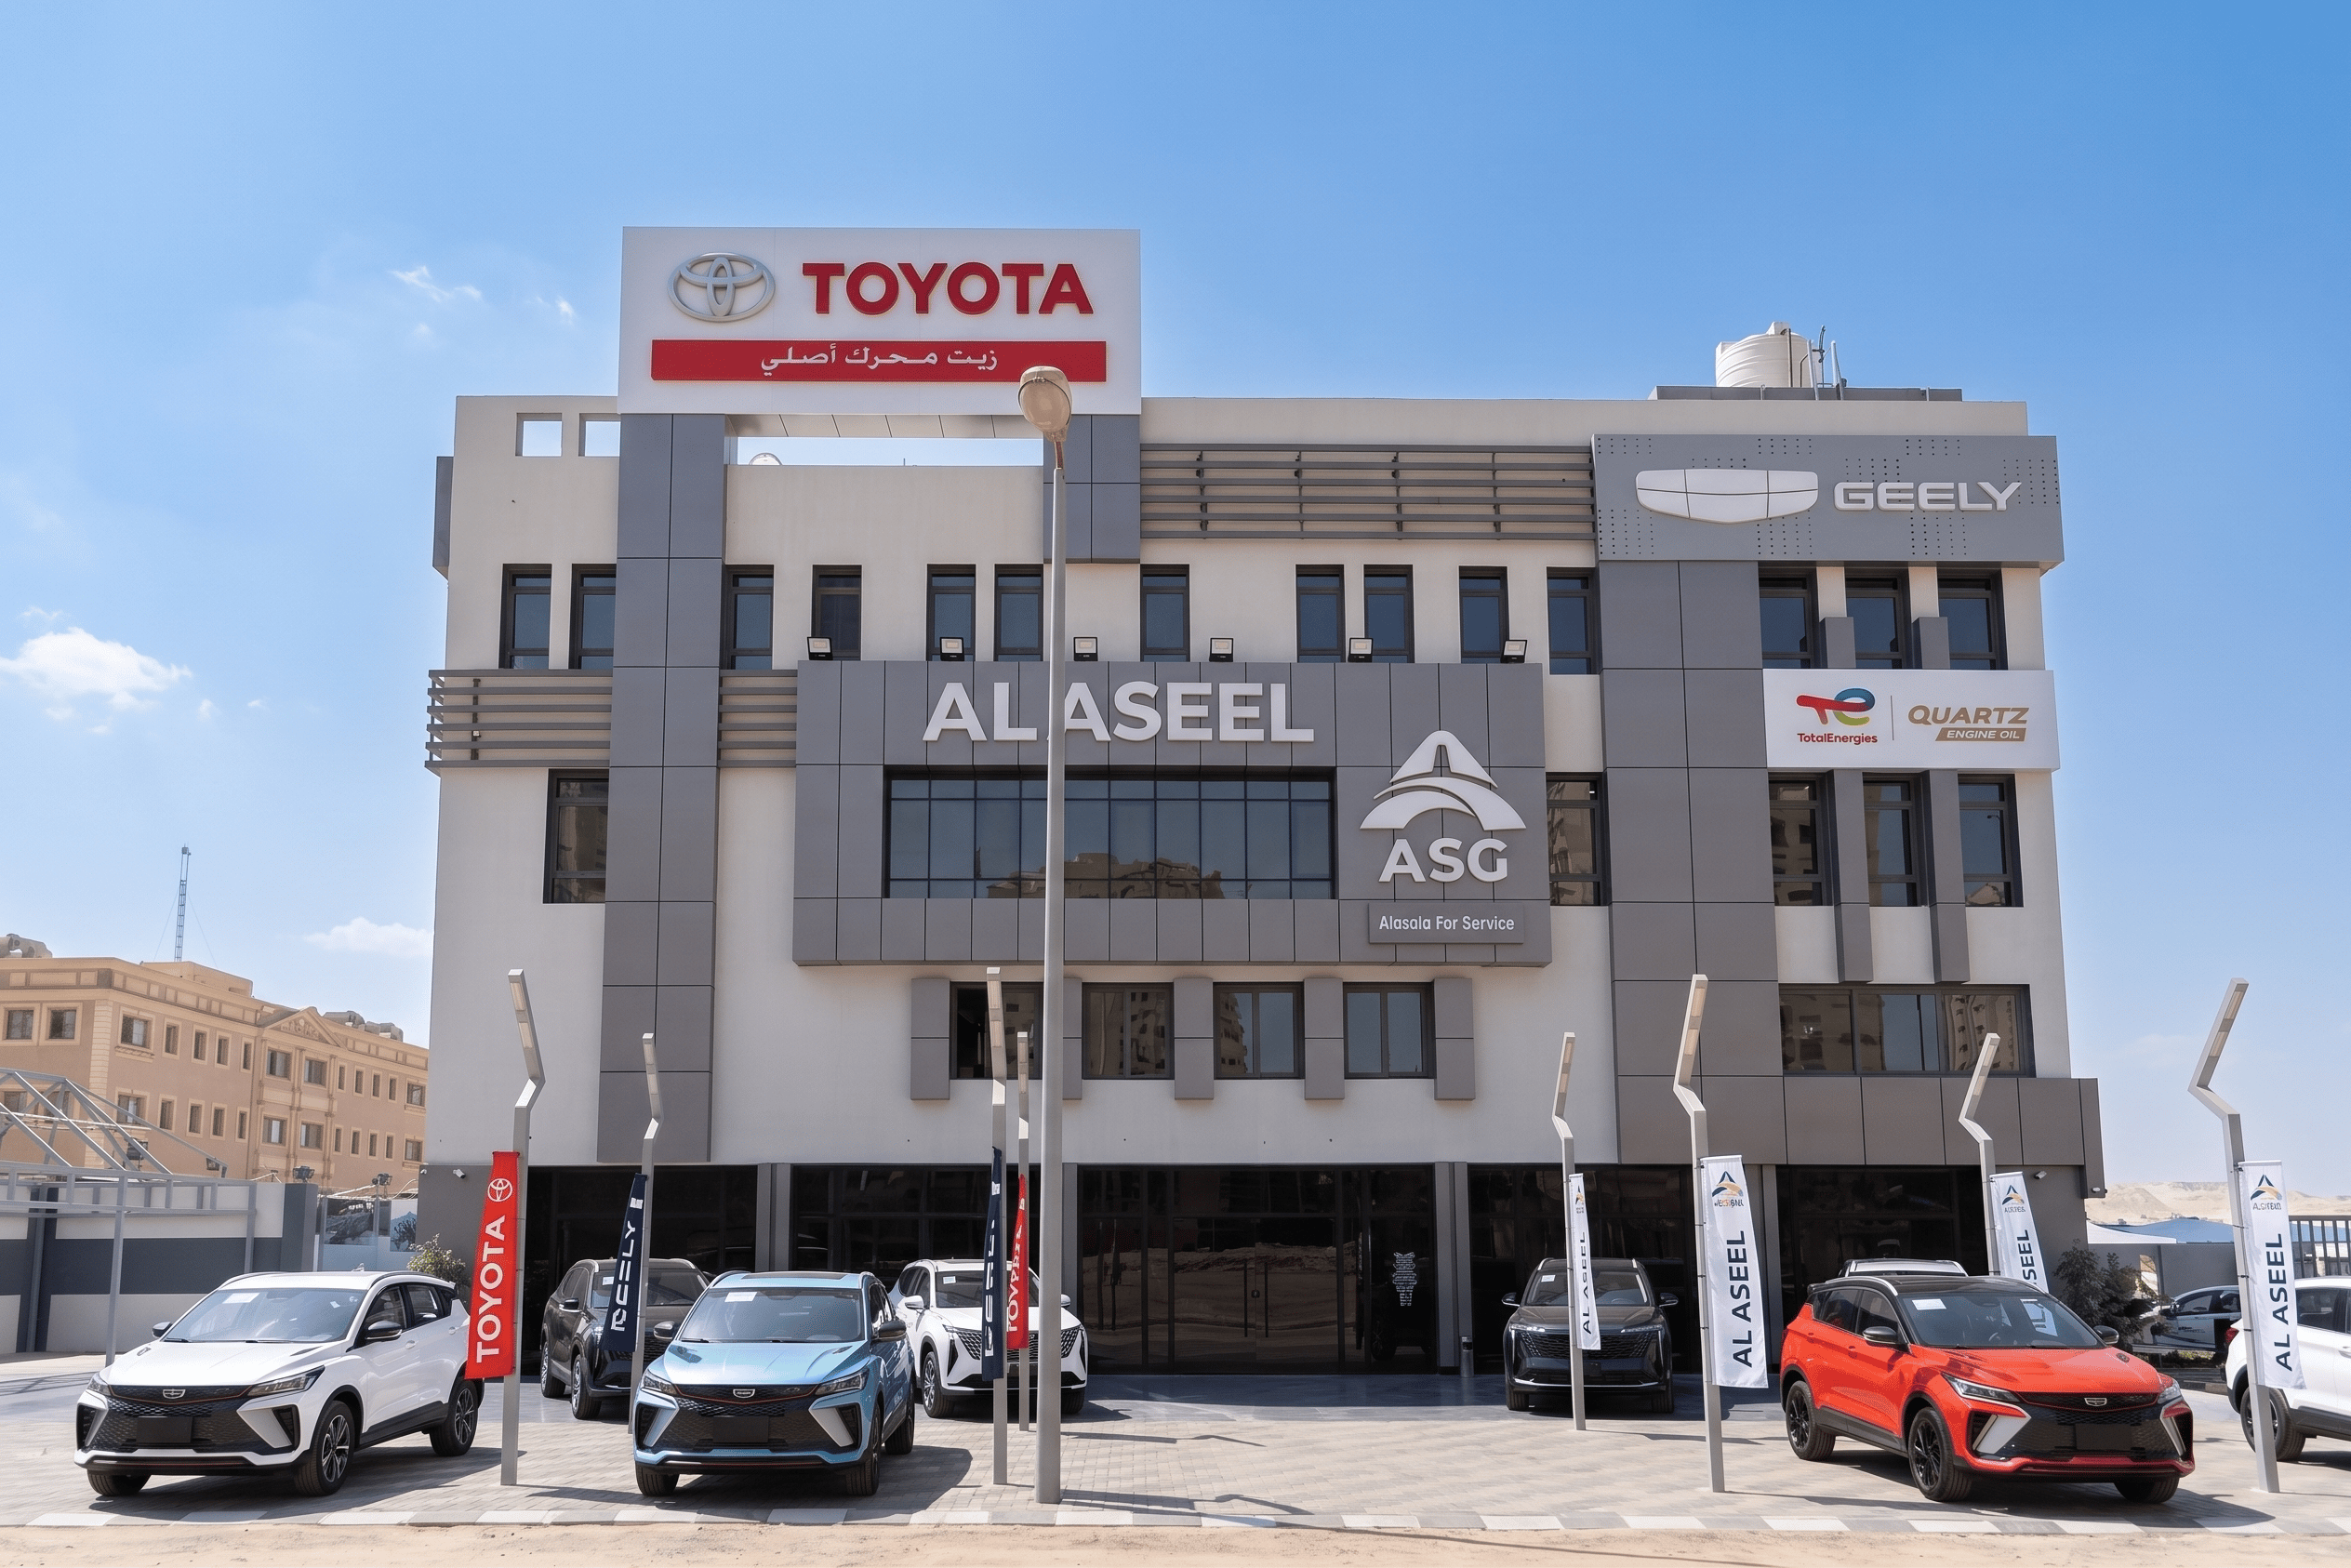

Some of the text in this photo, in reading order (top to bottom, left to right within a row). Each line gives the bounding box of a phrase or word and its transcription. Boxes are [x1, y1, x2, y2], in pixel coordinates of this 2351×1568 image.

[802, 261, 1094, 315] TOYOTA
[761, 343, 998, 377] زيت محرك أصلي
[1833, 482, 2023, 512] GEELY
[1908, 705, 2029, 725] QUARTZ
[1797, 733, 1878, 745] TotalEnergies
[1946, 730, 2020, 739] ENGINE OIL
[1378, 838, 1508, 883] ASG
[1379, 915, 1515, 930] Alasala For Service
[2017, 1229, 2038, 1284] SEEL
[476, 1215, 506, 1363] TOYOTA
[1726, 1230, 1752, 1322] ASEEL
[2265, 1233, 2289, 1324] ASEEL
[1583, 1307, 1592, 1335] AL
[1733, 1330, 1753, 1367] AL
[2275, 1335, 2292, 1371] AL
